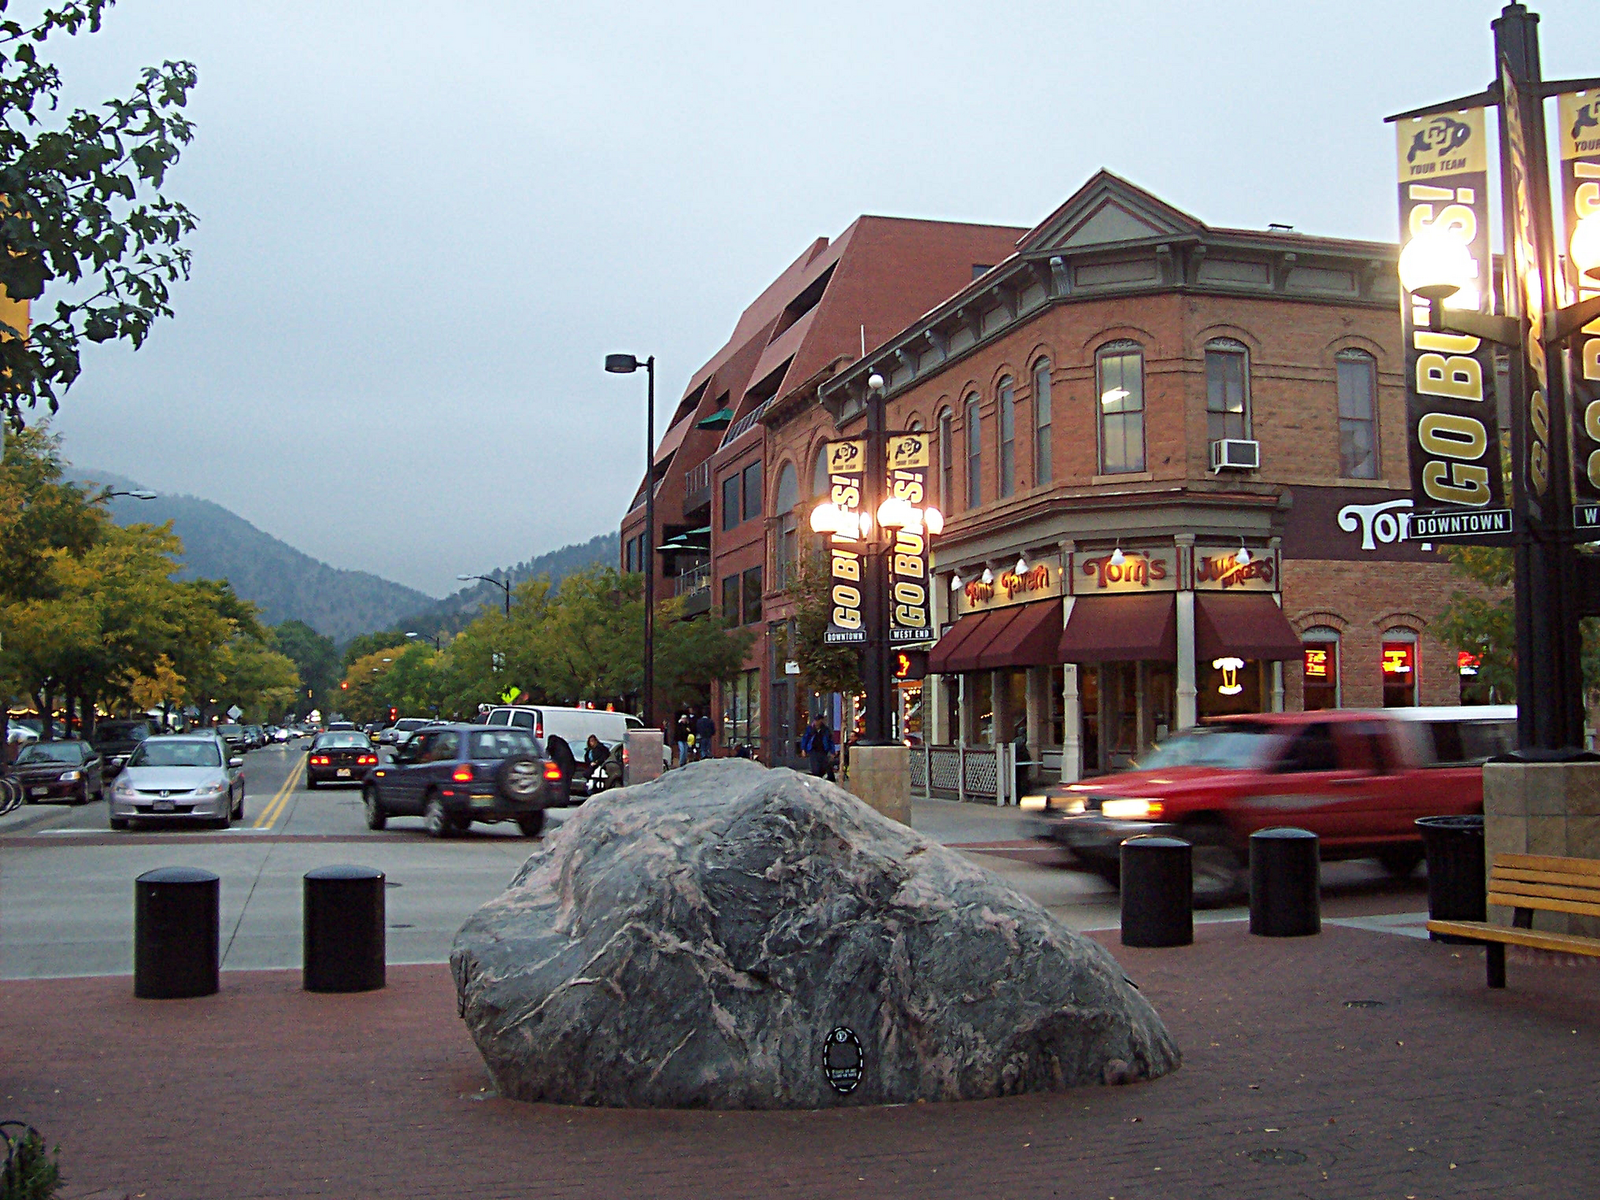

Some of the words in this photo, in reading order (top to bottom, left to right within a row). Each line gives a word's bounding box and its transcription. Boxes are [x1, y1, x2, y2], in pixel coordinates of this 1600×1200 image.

[1410, 162, 1437, 176] YOUR
[1440, 157, 1467, 171] TEAM
[1408, 184, 1484, 402] BUS!
[1417, 412, 1491, 507] GO
[831, 475, 860, 582] BUS!
[893, 470, 924, 579] BUS!
[1417, 513, 1504, 535] DOWNTOWN
[1082, 550, 1167, 588] Tom's
[1196, 550, 1254, 582] JUM
[832, 585, 862, 630] GO
[894, 582, 926, 628] GO
[827, 632, 863, 641] DOWNTOWN
[893, 630, 913, 639] WEST
[915, 629, 929, 638] END
